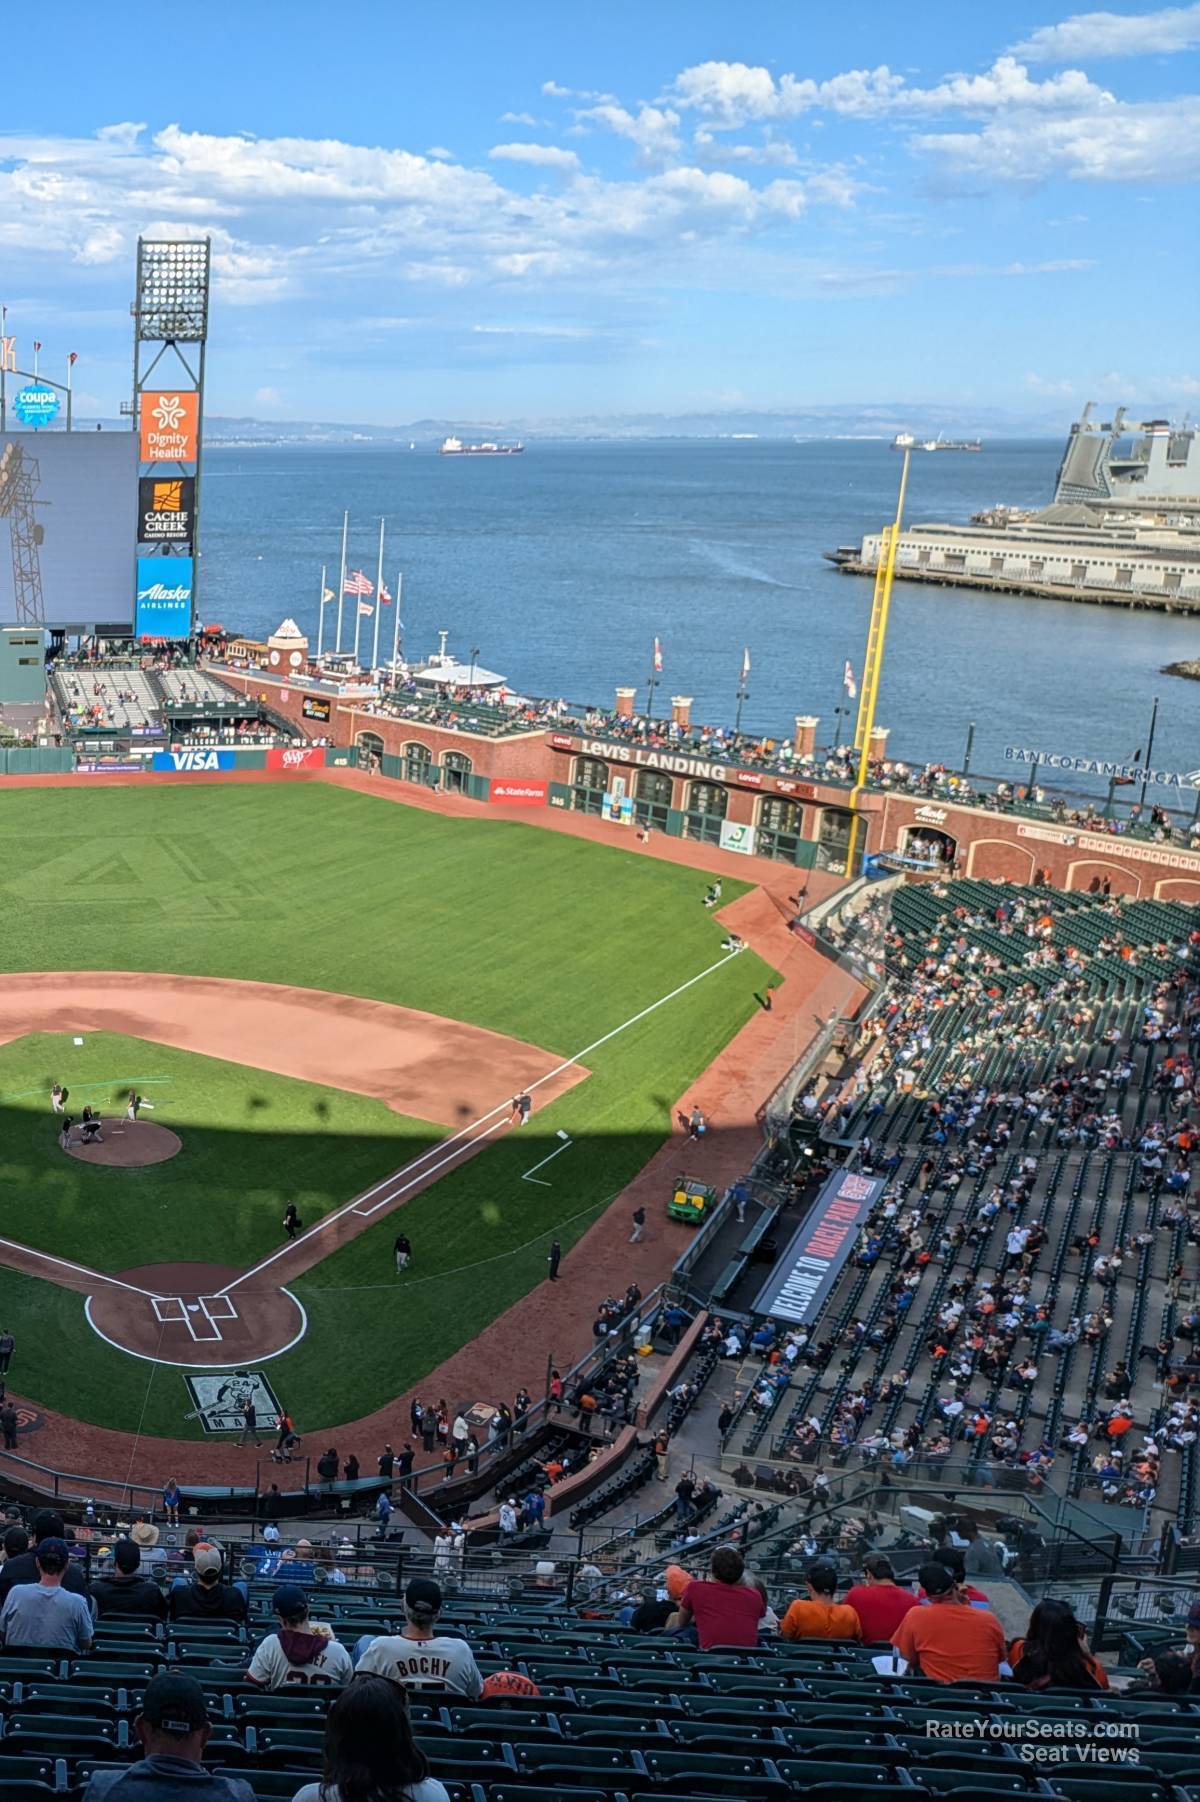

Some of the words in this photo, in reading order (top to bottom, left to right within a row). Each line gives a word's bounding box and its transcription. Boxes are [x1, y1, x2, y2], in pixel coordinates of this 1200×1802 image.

[19, 391, 56, 405] coupa
[147, 432, 189, 447] Dignity
[149, 447, 186, 458] Health
[144, 512, 188, 522] CACHE
[145, 521, 186, 531] CREEK
[138, 583, 191, 601] Alaska
[259, 736, 274, 744] 415
[169, 751, 219, 770] VISA
[334, 757, 348, 766] 415
[635, 750, 727, 782] LANDING
[1004, 747, 1054, 766] BANK
[1059, 756, 1085, 770] OF
[1088, 761, 1180, 786] AMERICA
[551, 796, 565, 807] 365
[824, 1198, 862, 1224] PARK
[804, 1221, 850, 1258] ORACLE
[795, 1255, 831, 1272] TO
[769, 1270, 824, 1319] WELCOME
[212, 1416, 274, 1428] MAS
[396, 1656, 451, 1678] BOCHY
